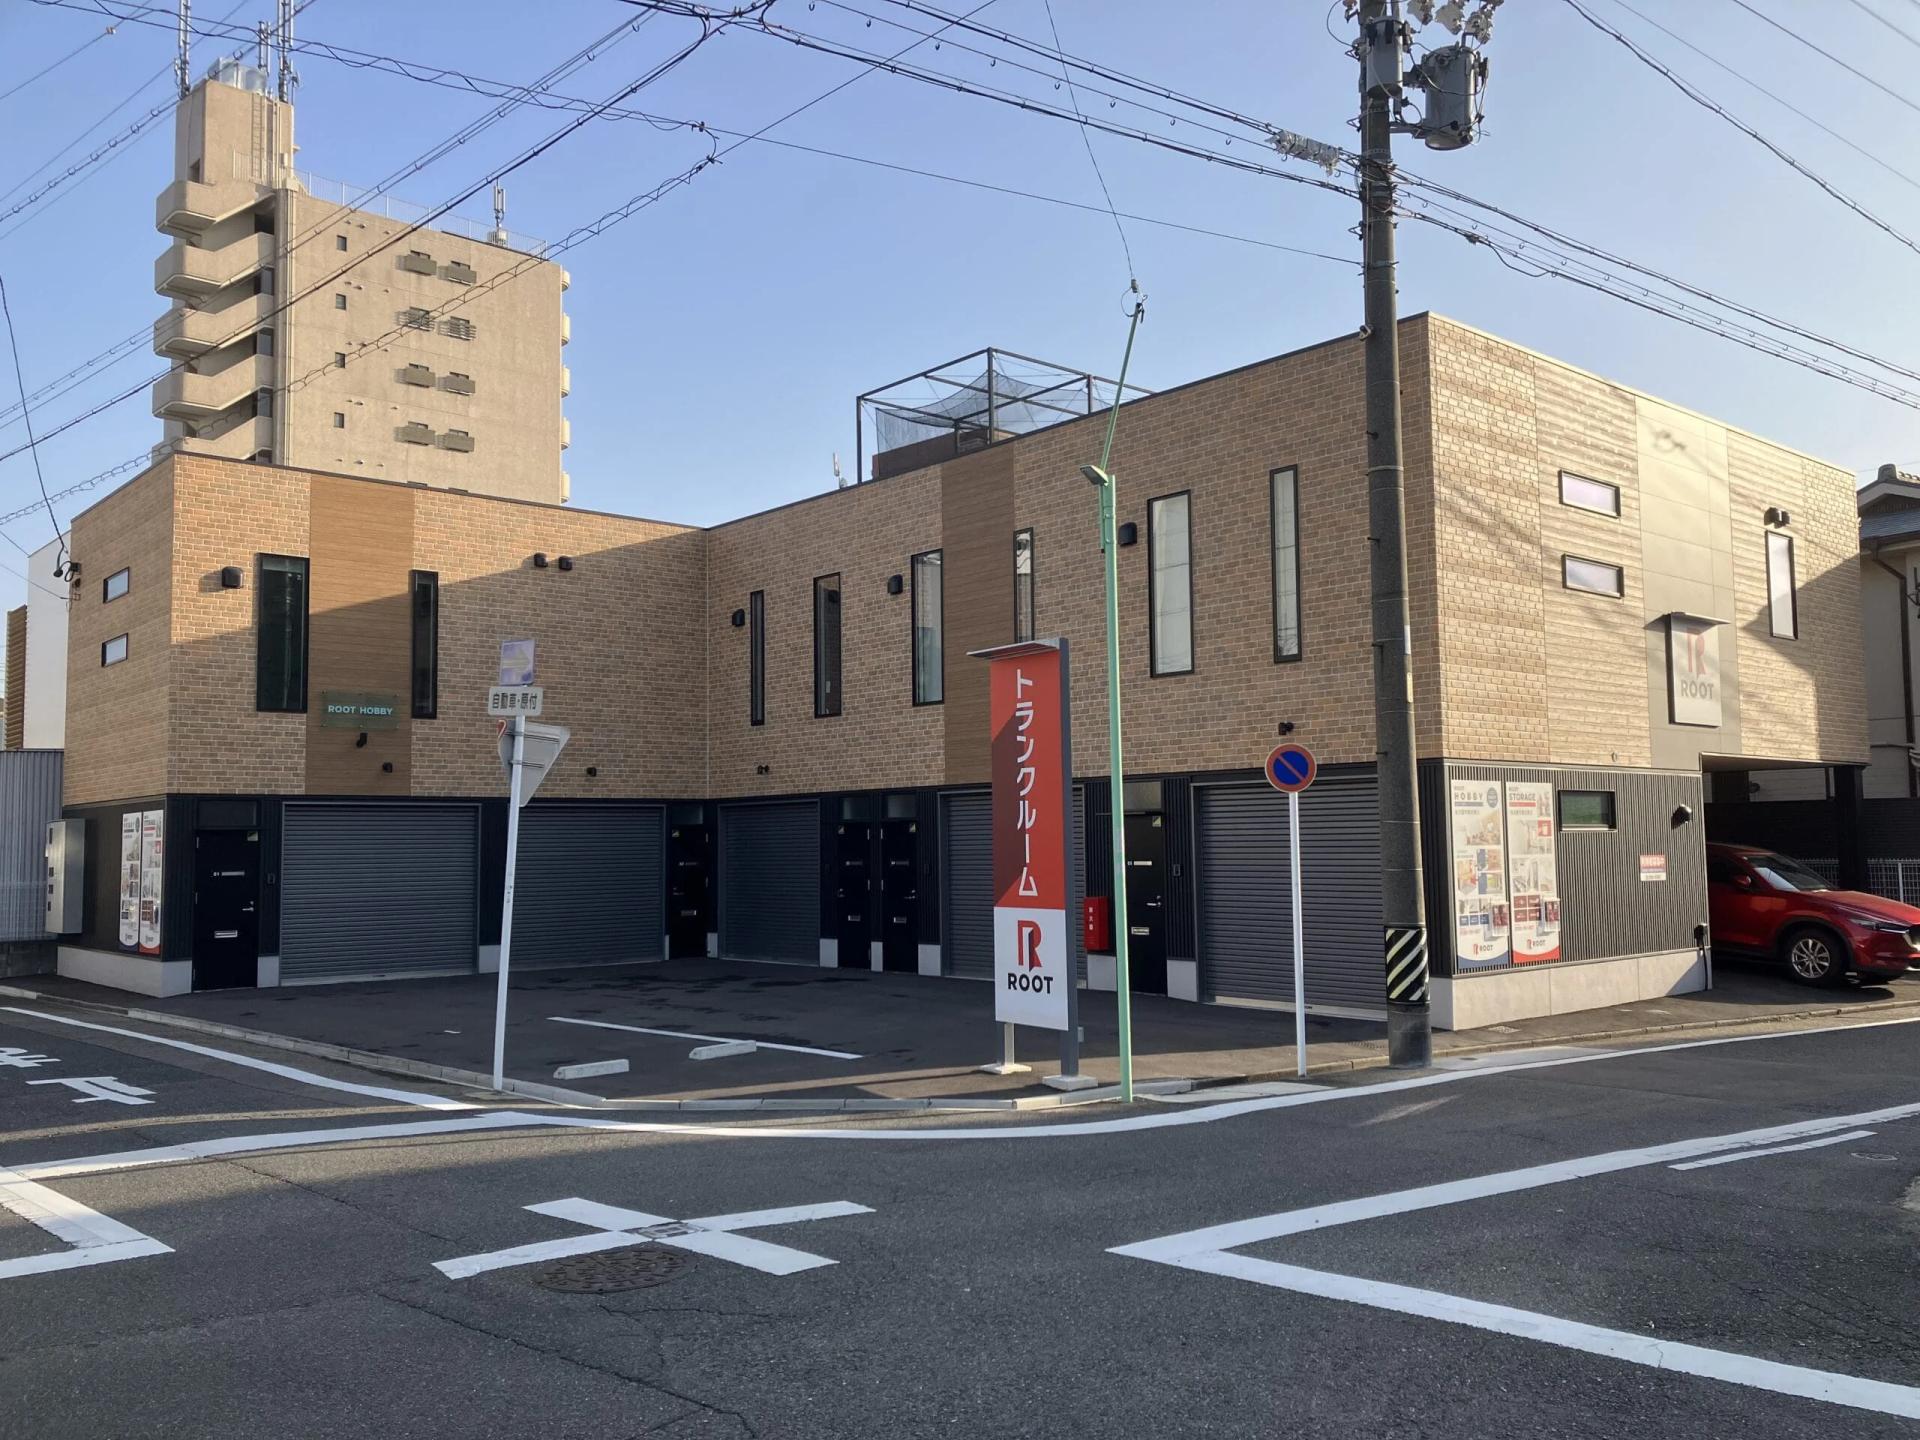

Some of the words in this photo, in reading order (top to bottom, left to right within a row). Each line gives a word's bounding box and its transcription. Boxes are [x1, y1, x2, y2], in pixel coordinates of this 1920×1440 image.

[1680, 680, 1714, 699] ROOT
[328, 705, 356, 713] ROOT
[360, 706, 393, 715] HOBBY
[1015, 668, 1038, 897] トランクルーム
[1454, 792, 1484, 801] HOBBY
[1508, 793, 1536, 801] STORAGE
[1007, 972, 1054, 995] ROOT
